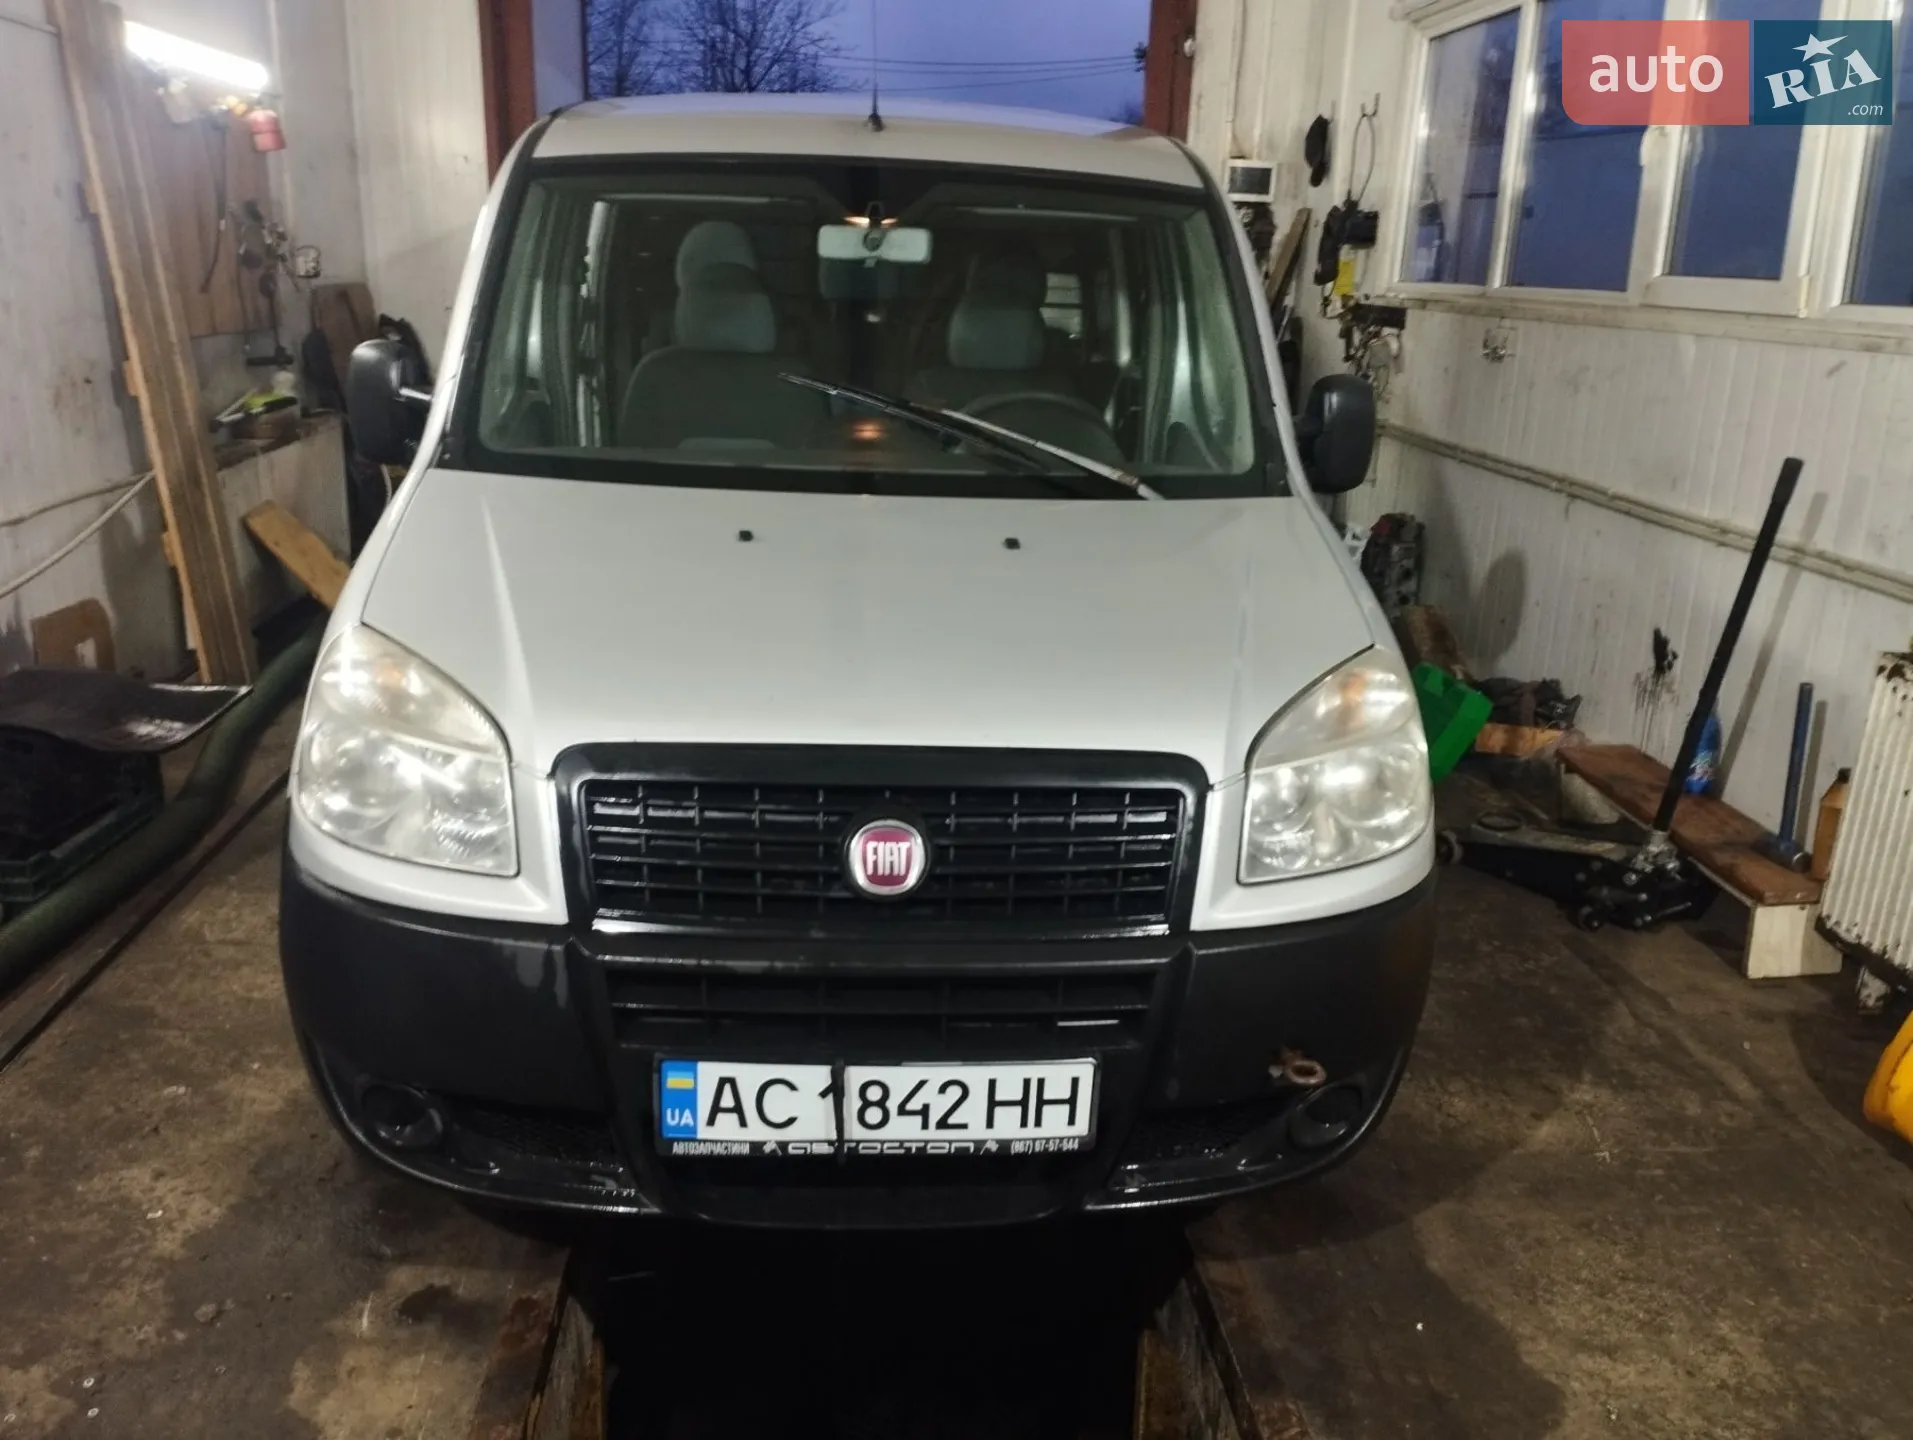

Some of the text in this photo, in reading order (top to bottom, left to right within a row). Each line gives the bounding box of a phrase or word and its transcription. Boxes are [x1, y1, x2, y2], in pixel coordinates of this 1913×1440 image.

[866, 841, 911, 876] FIAT
[706, 1076, 800, 1130] AC
[985, 1076, 1080, 1130] HH
[666, 1108, 694, 1127] UA
[672, 1140, 750, 1155] АВТОЗАПЧАСТИНИ
